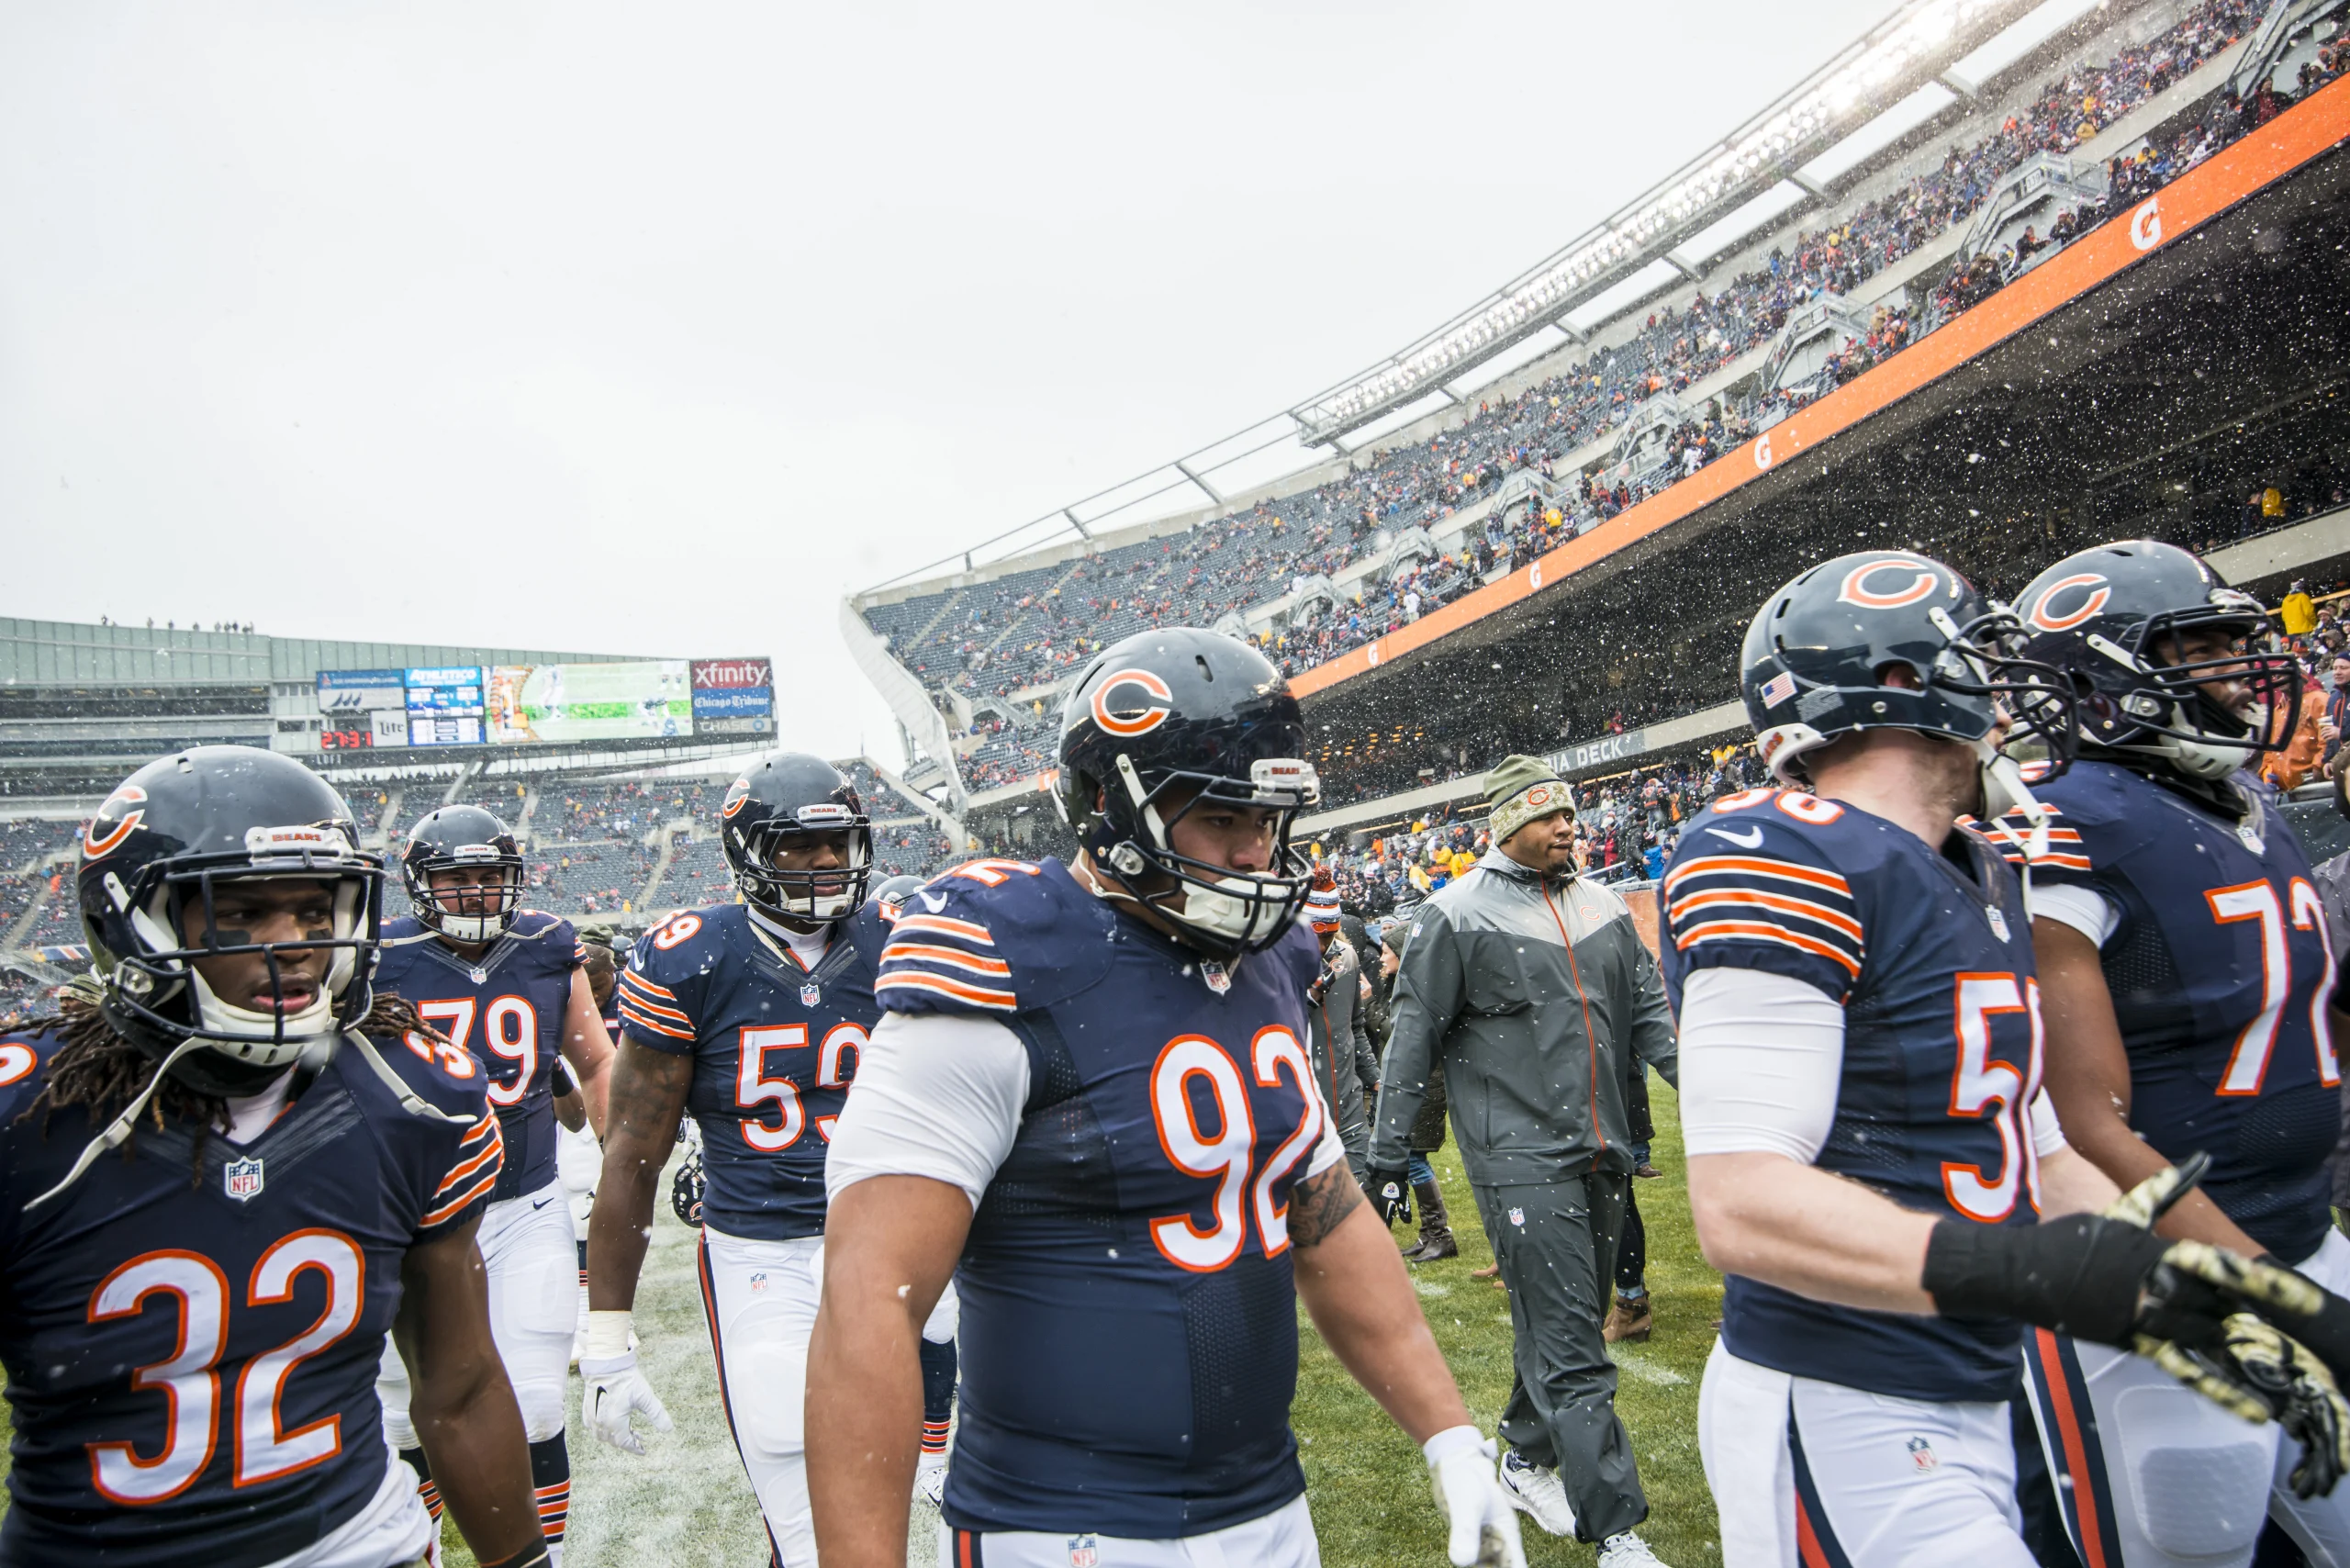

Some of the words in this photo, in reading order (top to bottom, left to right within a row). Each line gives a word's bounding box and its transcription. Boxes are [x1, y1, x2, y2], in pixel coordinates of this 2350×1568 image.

[2131, 196, 2162, 251] G
[1754, 433, 1772, 470] G
[1529, 561, 1542, 589] G
[1368, 644, 1379, 666] G
[695, 662, 769, 688] xfinity
[694, 697, 732, 709] Chicago
[732, 695, 769, 707] Tribune
[379, 721, 405, 736] Lite
[700, 720, 749, 733] CHASE
[1576, 737, 1624, 767] DECK
[272, 834, 322, 842] BEARS
[803, 993, 820, 1004] NFL
[418, 994, 538, 1105] 79
[1149, 1025, 1324, 1273] 92
[232, 1175, 259, 1193] NFL
[753, 1280, 767, 1291] NFL
[86, 1227, 365, 1506] 32
